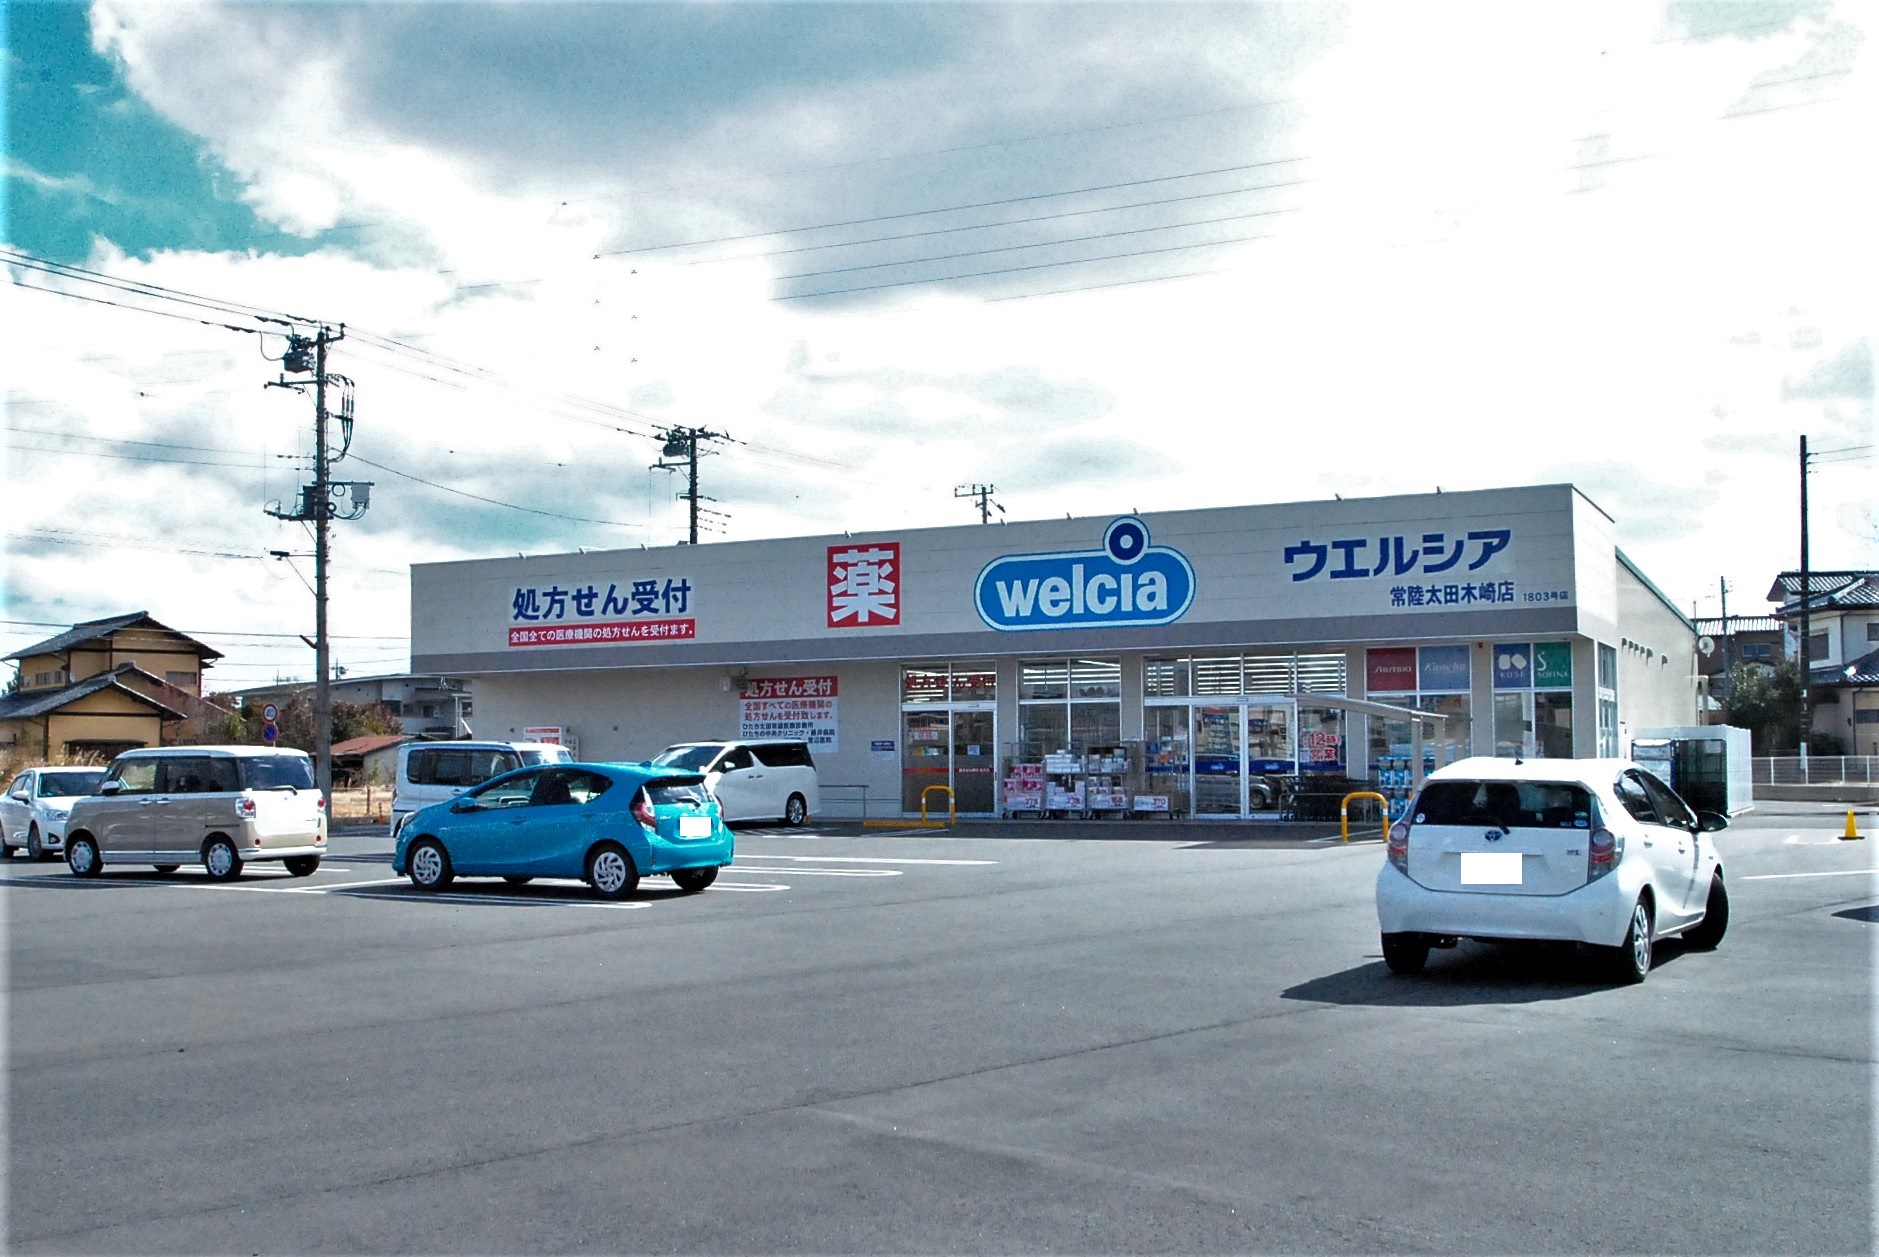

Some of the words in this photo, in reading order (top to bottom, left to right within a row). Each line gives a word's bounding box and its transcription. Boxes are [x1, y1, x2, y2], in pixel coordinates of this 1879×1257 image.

[1284, 529, 1511, 582] ウエルシア
[830, 547, 898, 622] 薬
[995, 562, 1168, 617] welcia
[1390, 580, 1515, 607] 常陸太田木崎店
[1523, 590, 1569, 602] 1803号店
[512, 578, 691, 621] 処方せん受付
[510, 623, 693, 643] 全国全ての医療機関の処方せんを受付ます。
[745, 679, 832, 697] 処方せん受付
[1537, 671, 1569, 679] SOFINA
